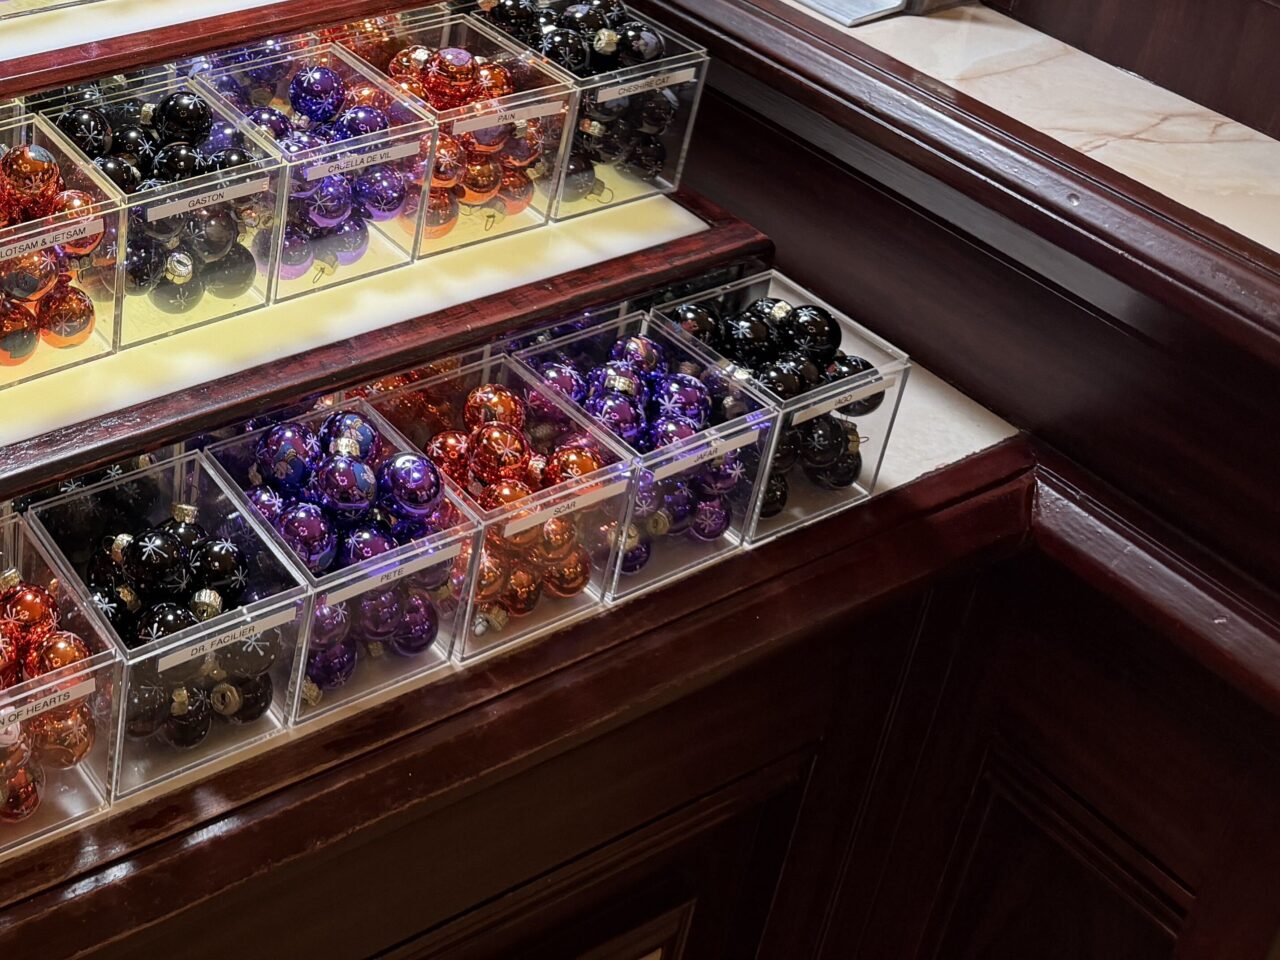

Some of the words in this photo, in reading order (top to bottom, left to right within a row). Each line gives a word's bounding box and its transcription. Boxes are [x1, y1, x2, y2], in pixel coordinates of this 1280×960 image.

[617, 80, 655, 96] CHESHIRE
[654, 76, 671, 86] CAT
[497, 113, 516, 123] PAIN
[327, 157, 366, 173] CRUELLA
[366, 155, 378, 164] DE
[378, 151, 392, 160] VIL
[188, 192, 225, 208] GASTON
[40, 238, 48, 246] &
[49, 226, 87, 245] JETSAM
[694, 447, 718, 463] JAFAR
[553, 501, 576, 516] SCAR
[380, 567, 404, 583] PETE
[190, 645, 208, 658] DR.
[209, 625, 256, 649] FACILIER
[6, 710, 24, 724] OF
[25, 691, 71, 715] HEARTS
